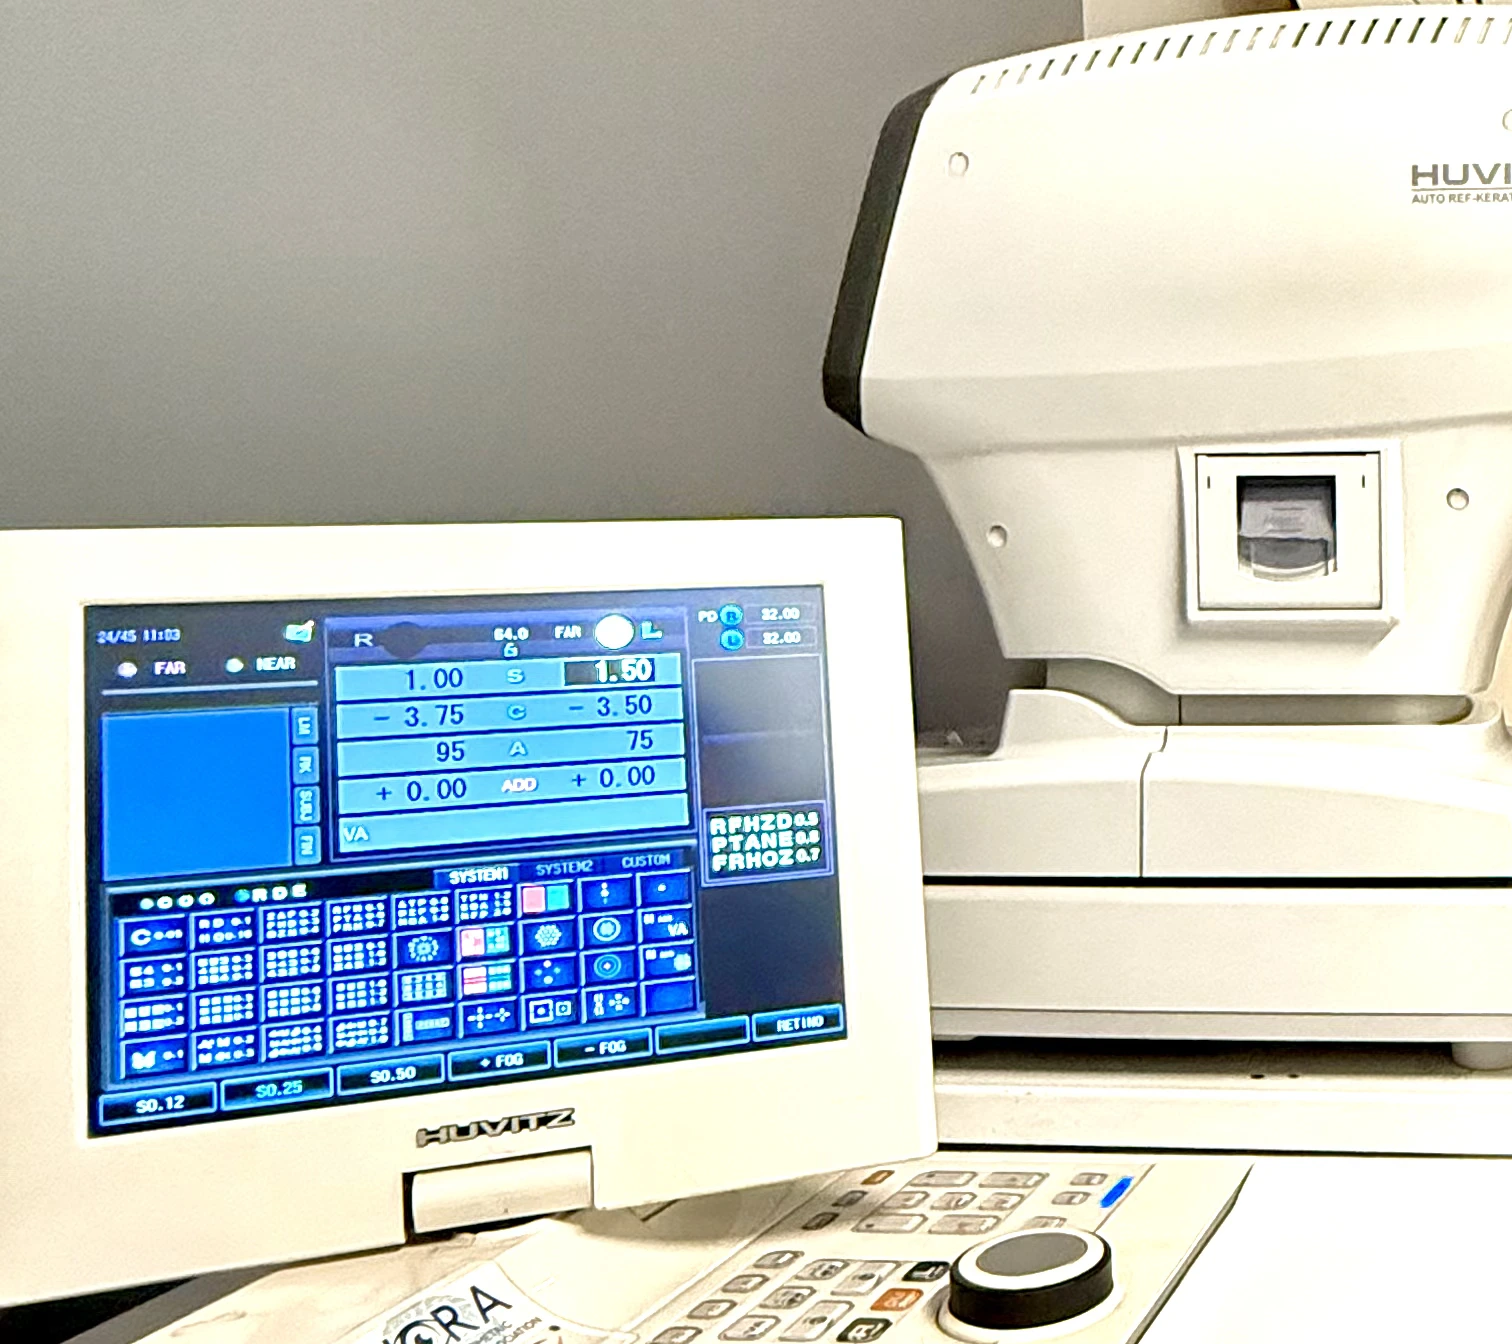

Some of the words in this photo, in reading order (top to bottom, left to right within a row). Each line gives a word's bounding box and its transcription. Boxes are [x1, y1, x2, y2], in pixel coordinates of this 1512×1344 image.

[1411, 193, 1445, 204] AUTO
[697, 610, 718, 623] PD
[354, 633, 374, 647] R
[554, 624, 582, 639] FAR
[153, 660, 187, 675] FAR
[255, 656, 297, 672] NEAR
[404, 667, 463, 690] 1.00
[507, 668, 524, 683] S
[594, 658, 653, 684] 1.50
[403, 704, 464, 727] 3.75
[597, 694, 652, 718] 3.50
[436, 740, 465, 762] 95
[509, 740, 528, 756] A
[626, 730, 653, 751] 75
[406, 778, 467, 802] 0.00
[501, 777, 538, 793] ADD
[599, 765, 655, 788] 0.00
[710, 812, 793, 836] RFHZD
[343, 825, 369, 843] VA
[711, 830, 795, 854] PTANE
[536, 859, 594, 877] SYSTEM2
[621, 853, 671, 869] CUSTOM
[712, 848, 795, 872] FRHOZ
[796, 846, 821, 863] 0.7
[449, 866, 509, 885] SYSTEM1
[599, 1039, 626, 1055] FOG
[496, 1052, 523, 1068] FOG
[415, 1107, 576, 1148] HUVITZ
